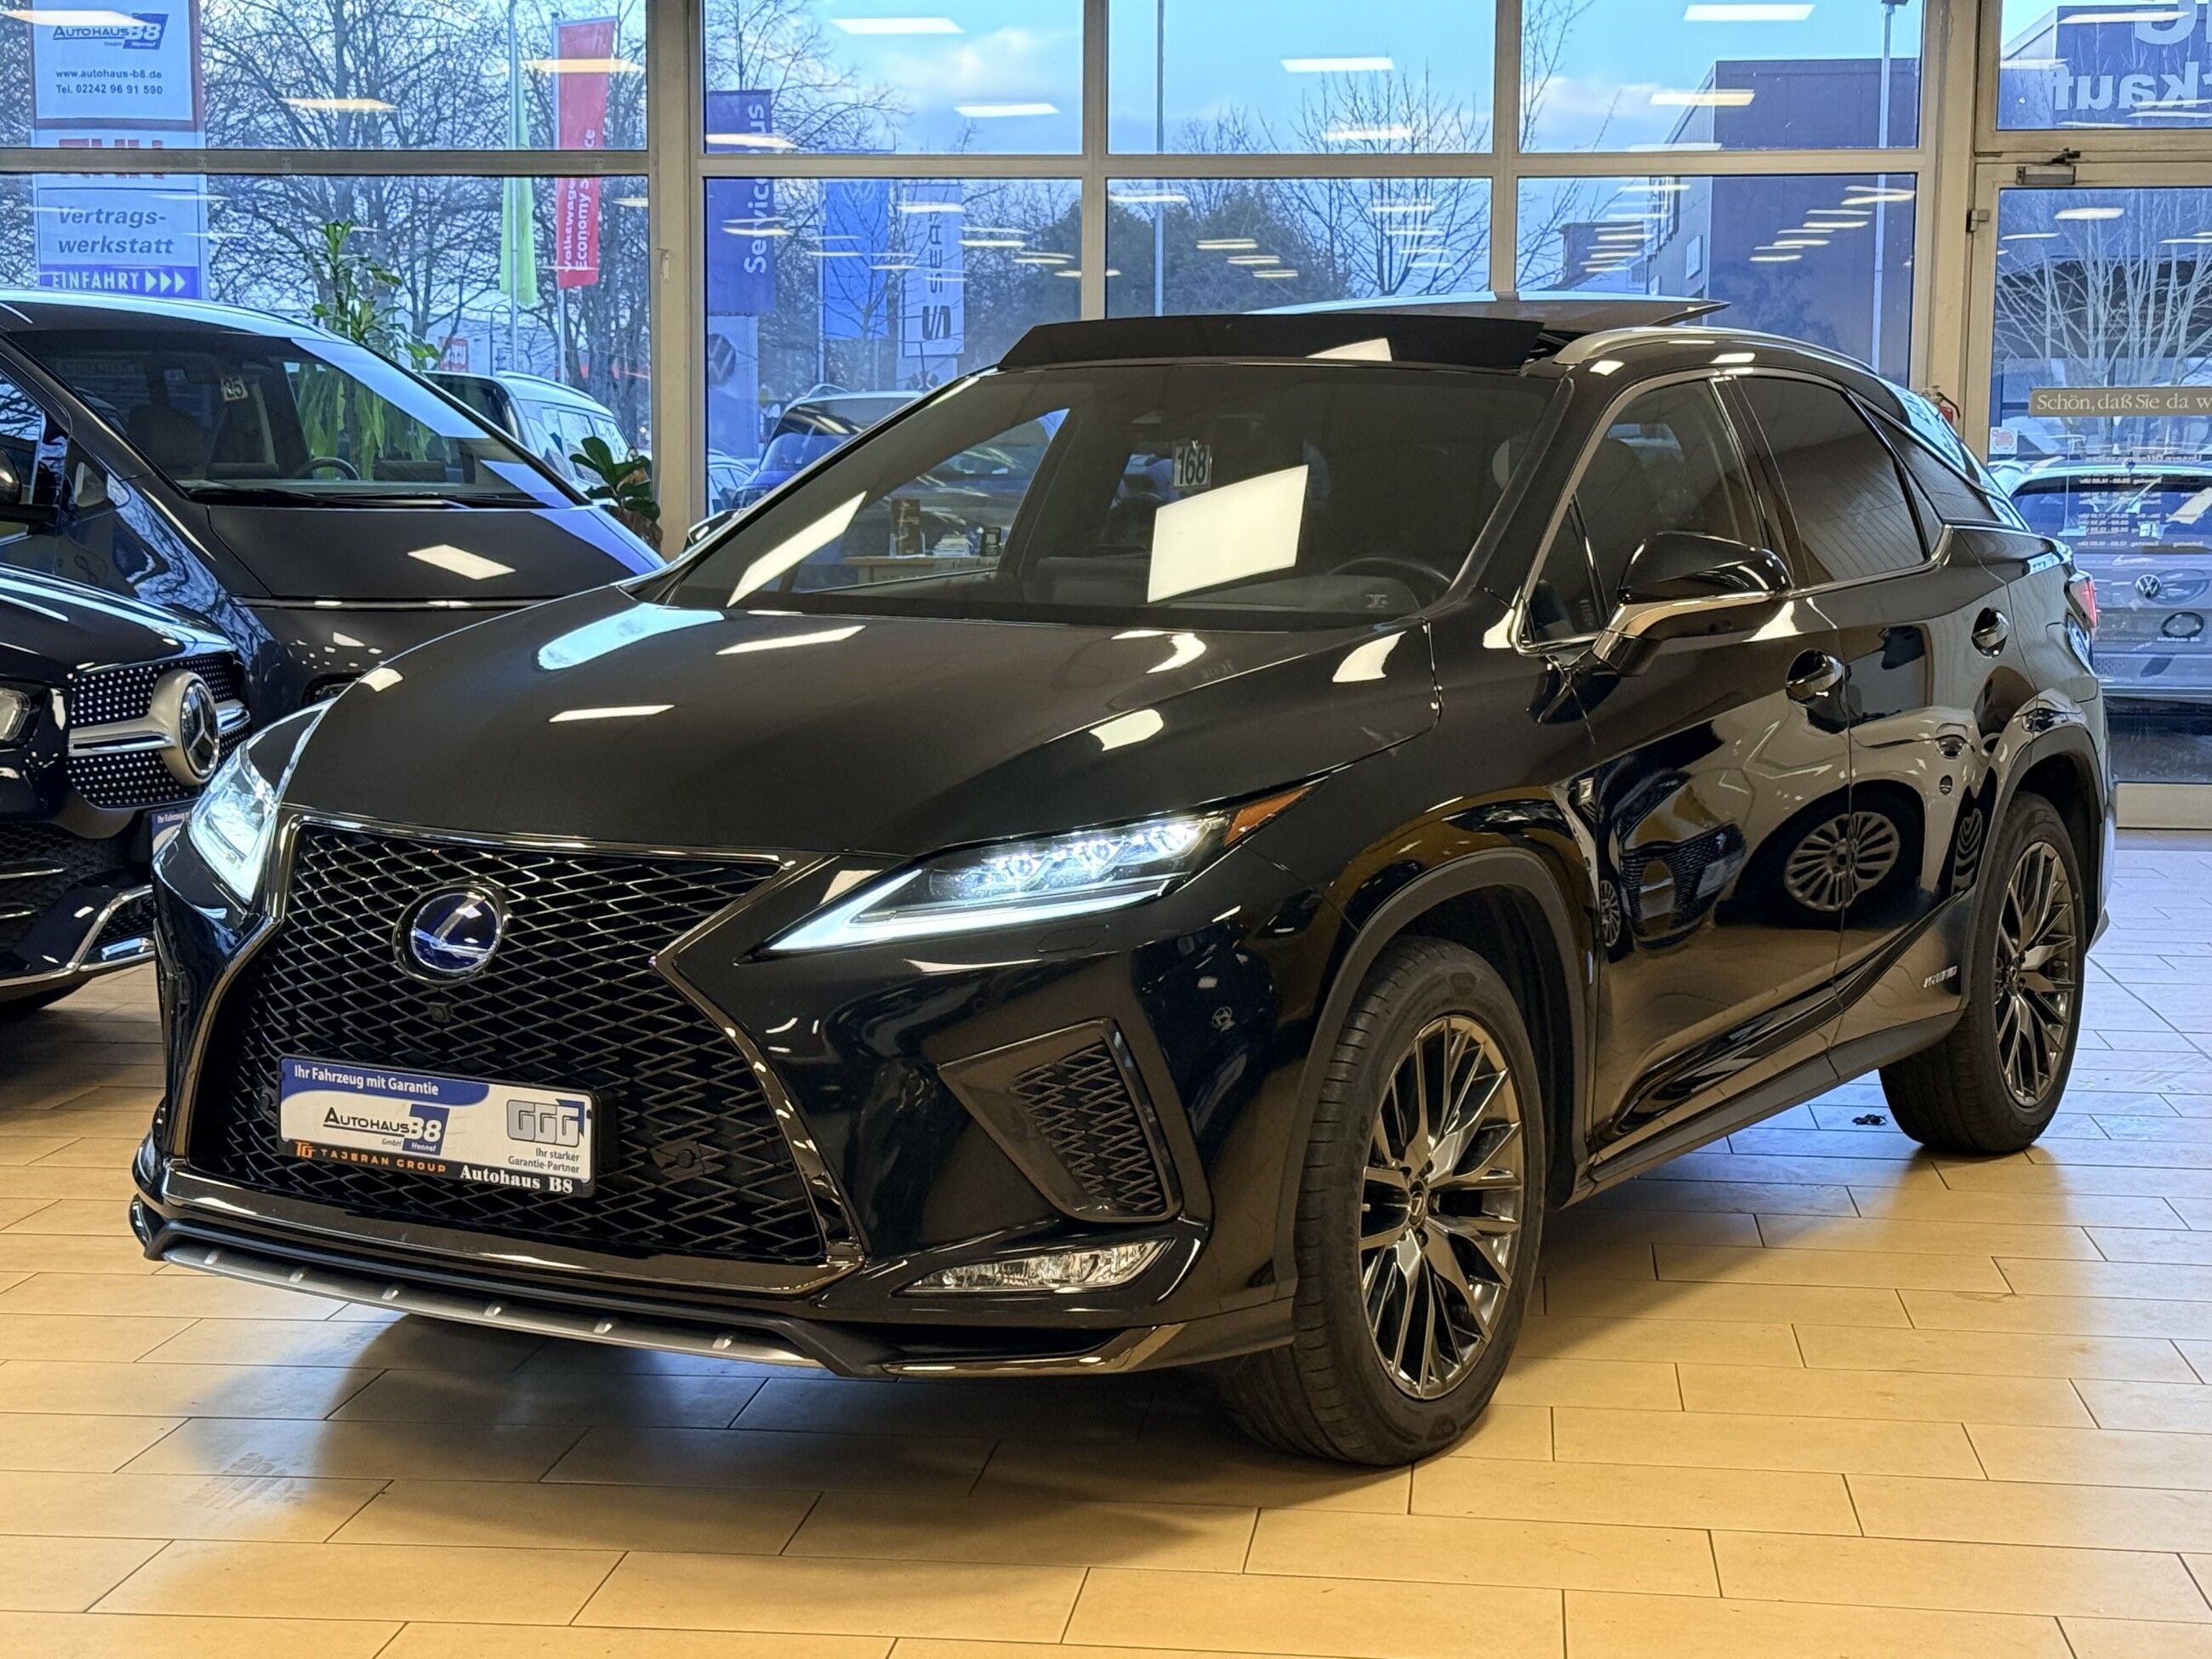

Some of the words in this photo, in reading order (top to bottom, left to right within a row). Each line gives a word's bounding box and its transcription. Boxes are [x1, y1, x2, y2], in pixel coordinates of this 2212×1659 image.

[53, 26, 129, 37] AUTOHAUS
[55, 69, 162, 79] www.autohaus-b8.de
[56, 84, 73, 94] Tel.
[76, 83, 107, 94] 02242
[110, 84, 123, 94] 96
[127, 84, 140, 94] 91
[143, 85, 163, 94] 590
[58, 206, 167, 229] Vertrags-
[563, 178, 577, 272] Volkswage
[575, 191, 592, 270] Economy
[58, 235, 174, 254] werkstatt
[52, 271, 140, 290] EINFAHRT
[2036, 393, 2095, 412] Schön,
[2097, 392, 2132, 410] daß
[2135, 394, 2160, 410] Sie
[2166, 392, 2191, 410] da
[1177, 446, 1207, 485] 168
[294, 1064, 311, 1080] Ihr
[311, 1067, 364, 1089] Fahrzeug
[366, 1075, 386, 1089] mit
[388, 1078, 440, 1096] Garantie
[323, 1107, 410, 1133] AUTOHAUS
[381, 1137, 402, 1148] GmbH
[411, 1142, 437, 1152] Hennef
[508, 1155, 580, 1174] Garantie-Partner
[535, 1148, 548, 1158] Ihr
[550, 1149, 580, 1162] starker
[396, 1158, 447, 1173] GROUP
[459, 1165, 541, 1189] Autohaus
[548, 1177, 573, 1194] B8
